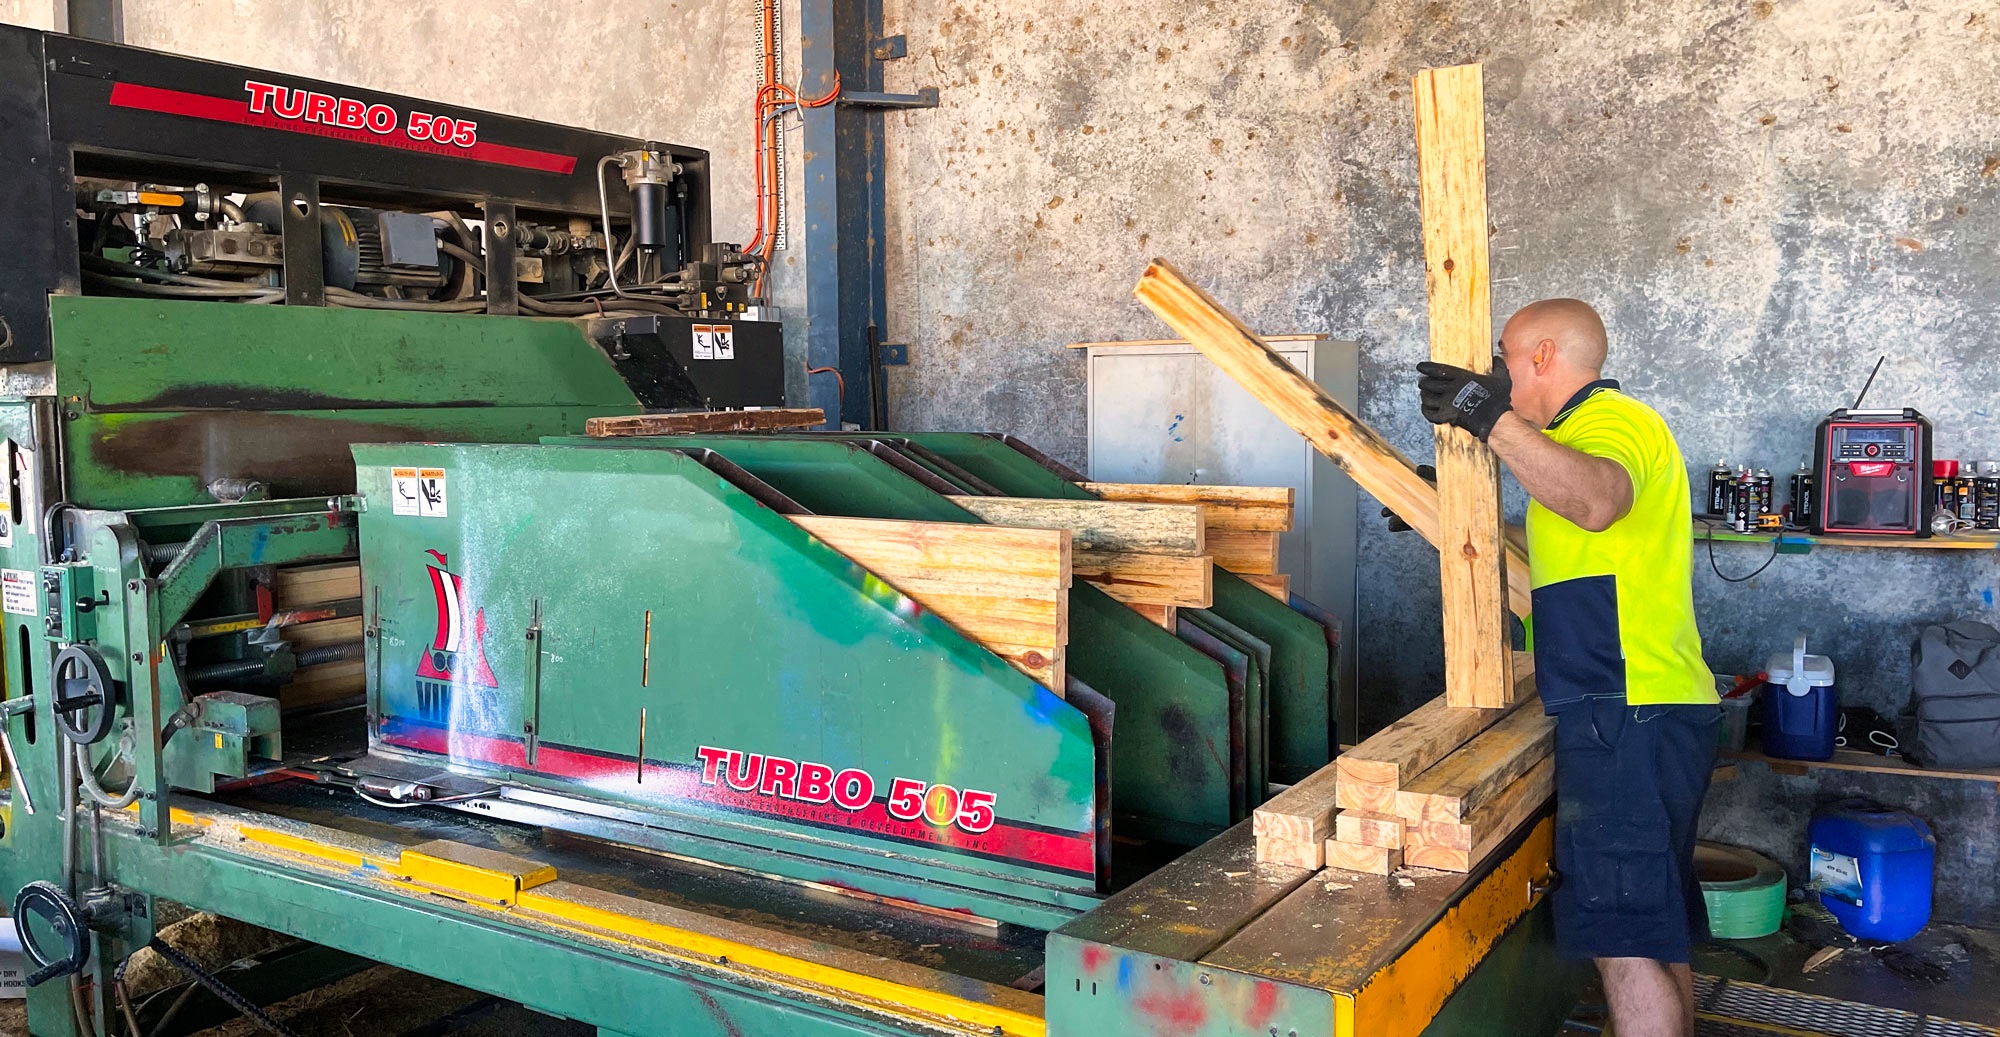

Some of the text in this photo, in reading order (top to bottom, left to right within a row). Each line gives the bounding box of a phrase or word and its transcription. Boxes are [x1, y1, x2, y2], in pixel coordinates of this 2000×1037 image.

[245, 80, 477, 148] TURBO 505
[697, 746, 997, 834] TURBO 505
